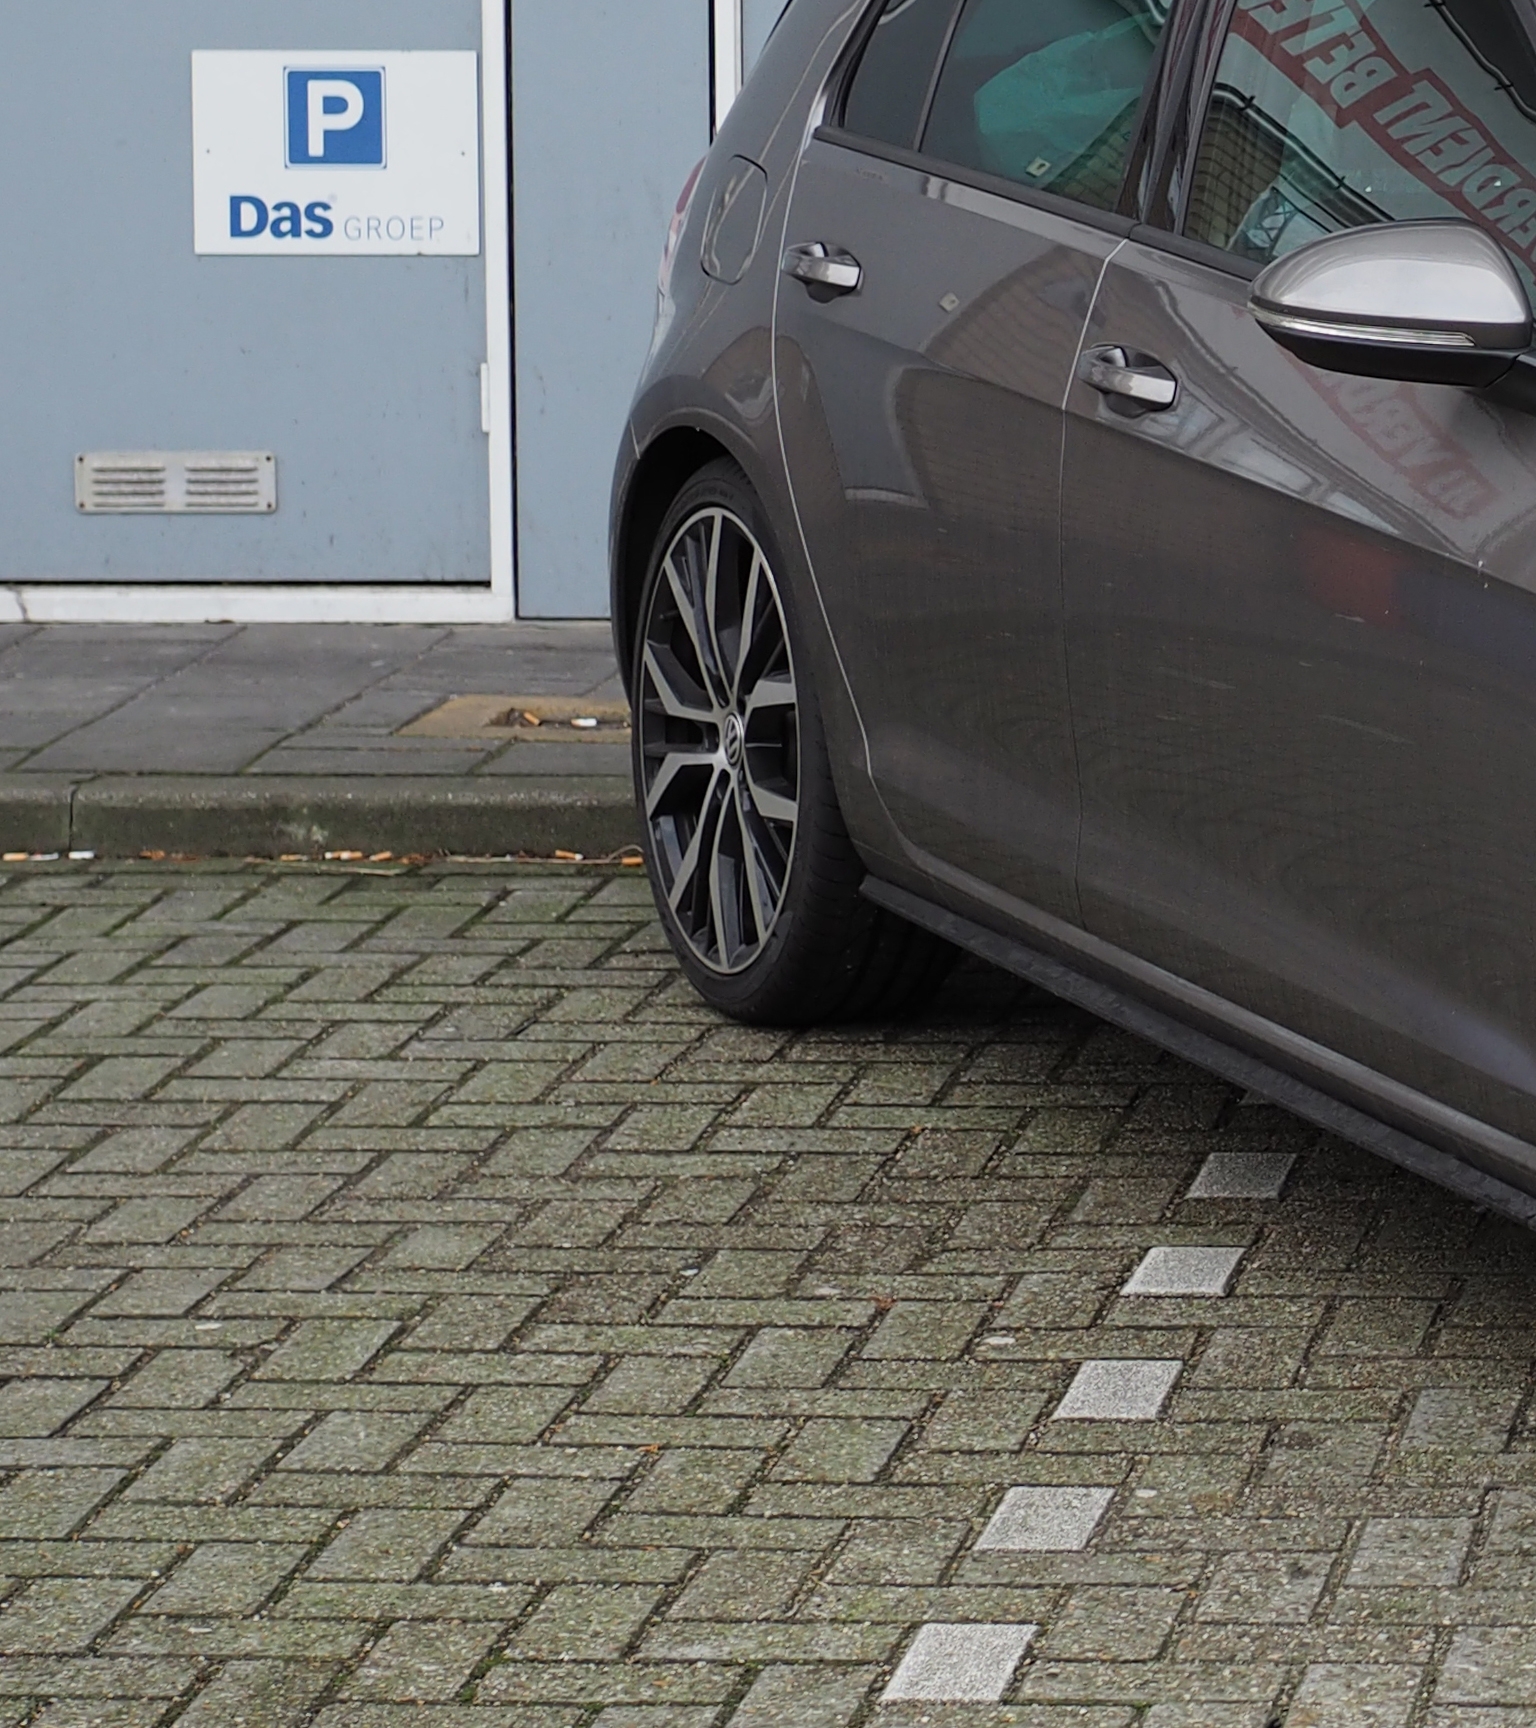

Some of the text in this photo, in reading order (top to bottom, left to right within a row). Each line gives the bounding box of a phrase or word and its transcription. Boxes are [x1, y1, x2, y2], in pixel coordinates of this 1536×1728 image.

[306, 78, 365, 158] P
[229, 195, 445, 242] Das GROEP
